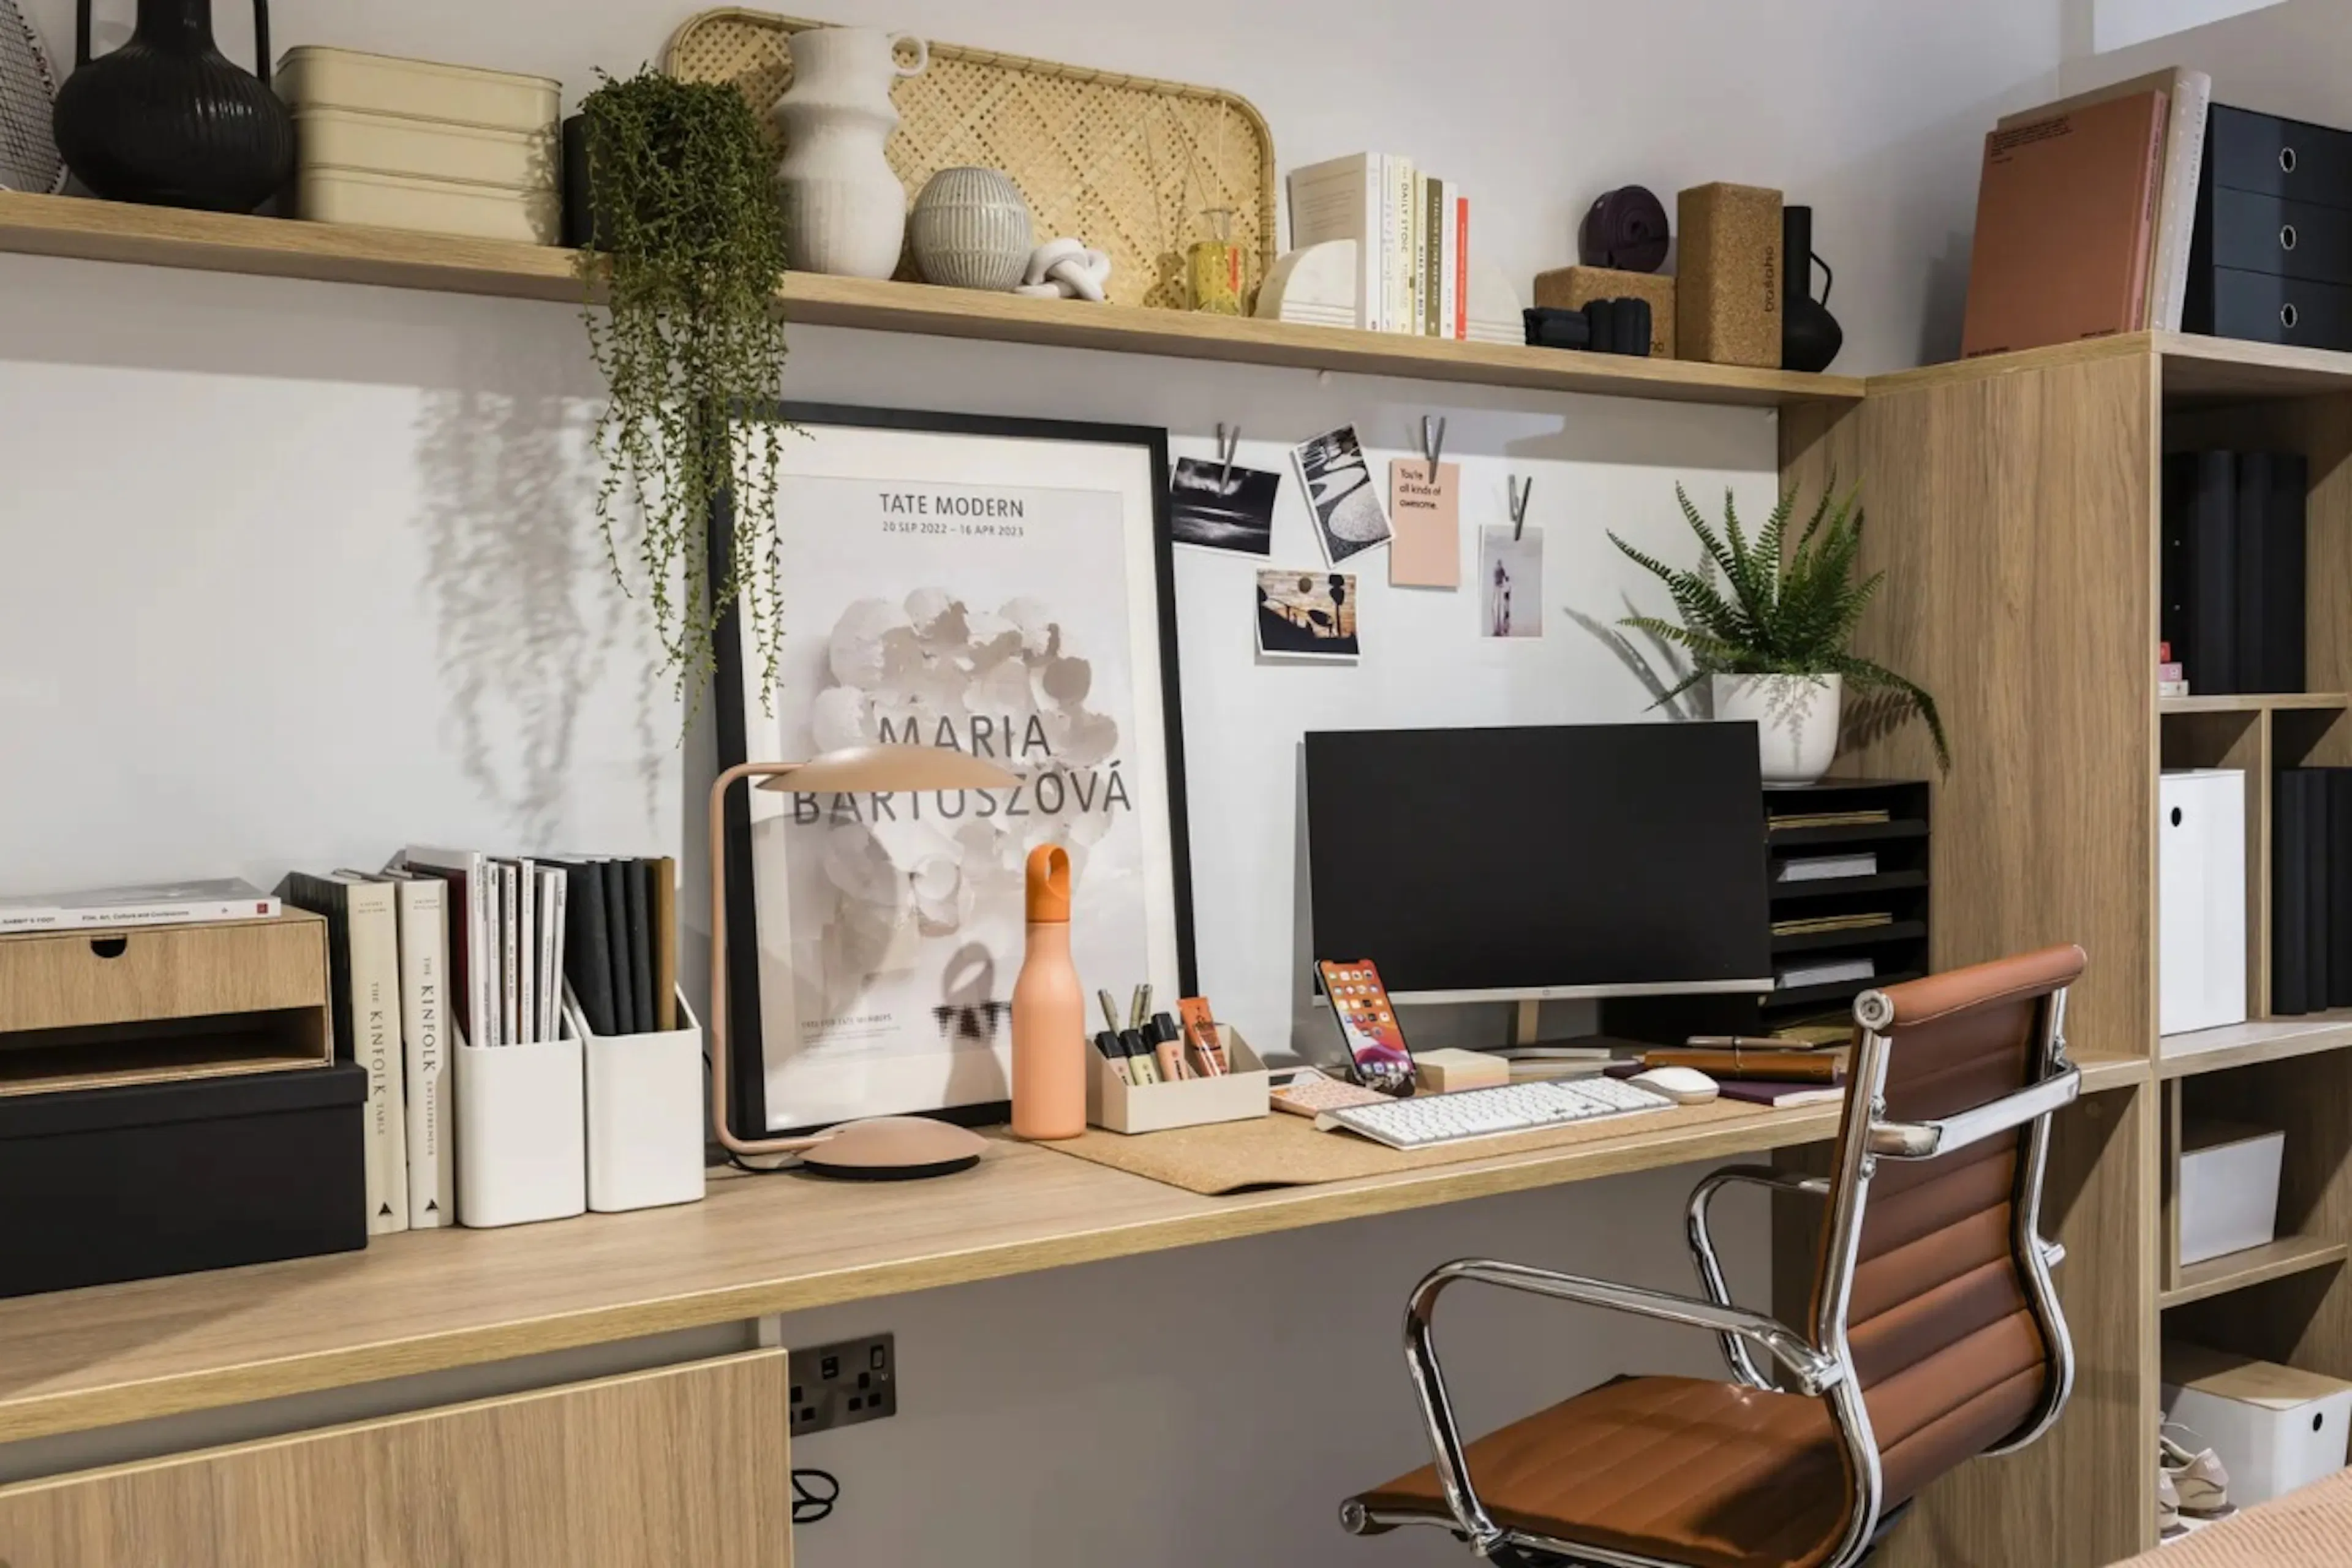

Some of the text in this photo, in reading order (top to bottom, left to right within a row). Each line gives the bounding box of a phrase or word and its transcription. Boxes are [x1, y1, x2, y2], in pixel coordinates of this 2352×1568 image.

[1400, 219, 1409, 253] STOIC
[880, 493, 1023, 518] TATE MODERN
[883, 521, 895, 532] 20
[899, 521, 918, 533] SEP
[920, 522, 948, 534] 2022
[960, 524, 971, 535] 16
[974, 524, 995, 535] APR
[998, 525, 1024, 537] 2023
[880, 715, 1051, 757] MARIA
[793, 760, 1131, 824] BARTUSZOVÁ
[421, 985, 436, 1072] KINFOLK
[930, 1001, 1012, 1039] TAT
[369, 982, 387, 1136] THE KINFOLK TABLE
